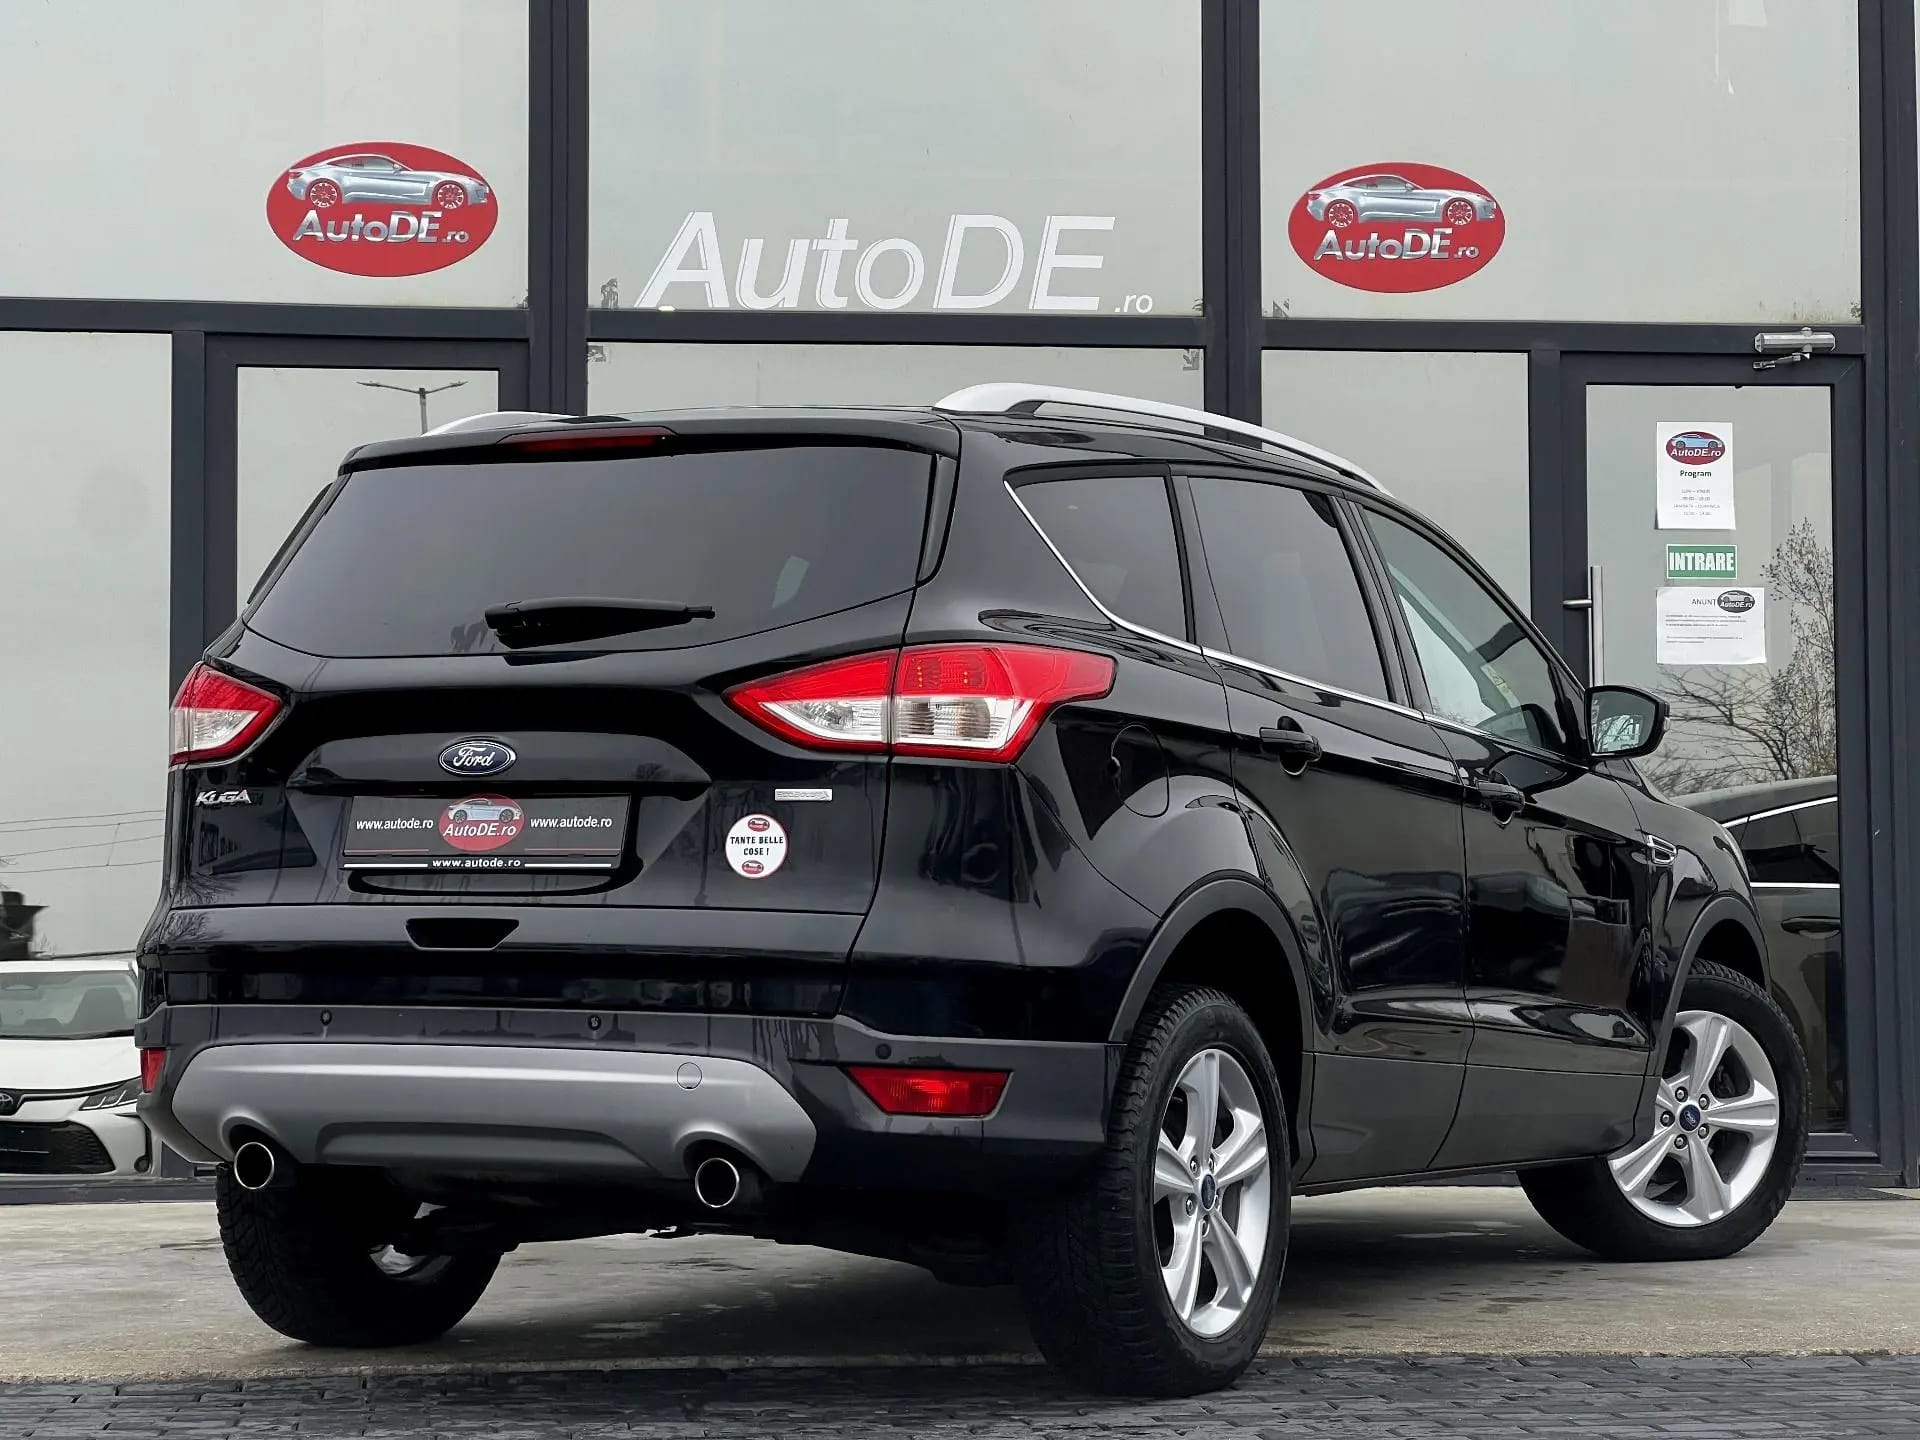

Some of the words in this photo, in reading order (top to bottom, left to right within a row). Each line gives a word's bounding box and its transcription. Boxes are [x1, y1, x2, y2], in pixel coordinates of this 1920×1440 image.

[1671, 448, 1721, 457] AutoDE.ro
[1680, 470, 1712, 478] Program
[1669, 552, 1735, 571] INTRARE
[453, 746, 495, 768] Ford
[194, 789, 252, 806] KUGA
[355, 817, 434, 830] www.autode.ro
[530, 815, 613, 829] www.autode.ro
[443, 822, 517, 838] AutoDE.ro
[730, 836, 756, 844] TANTE
[758, 836, 784, 844] BELLE
[743, 847, 764, 856] COSE
[432, 857, 521, 868] www.autode.ro
